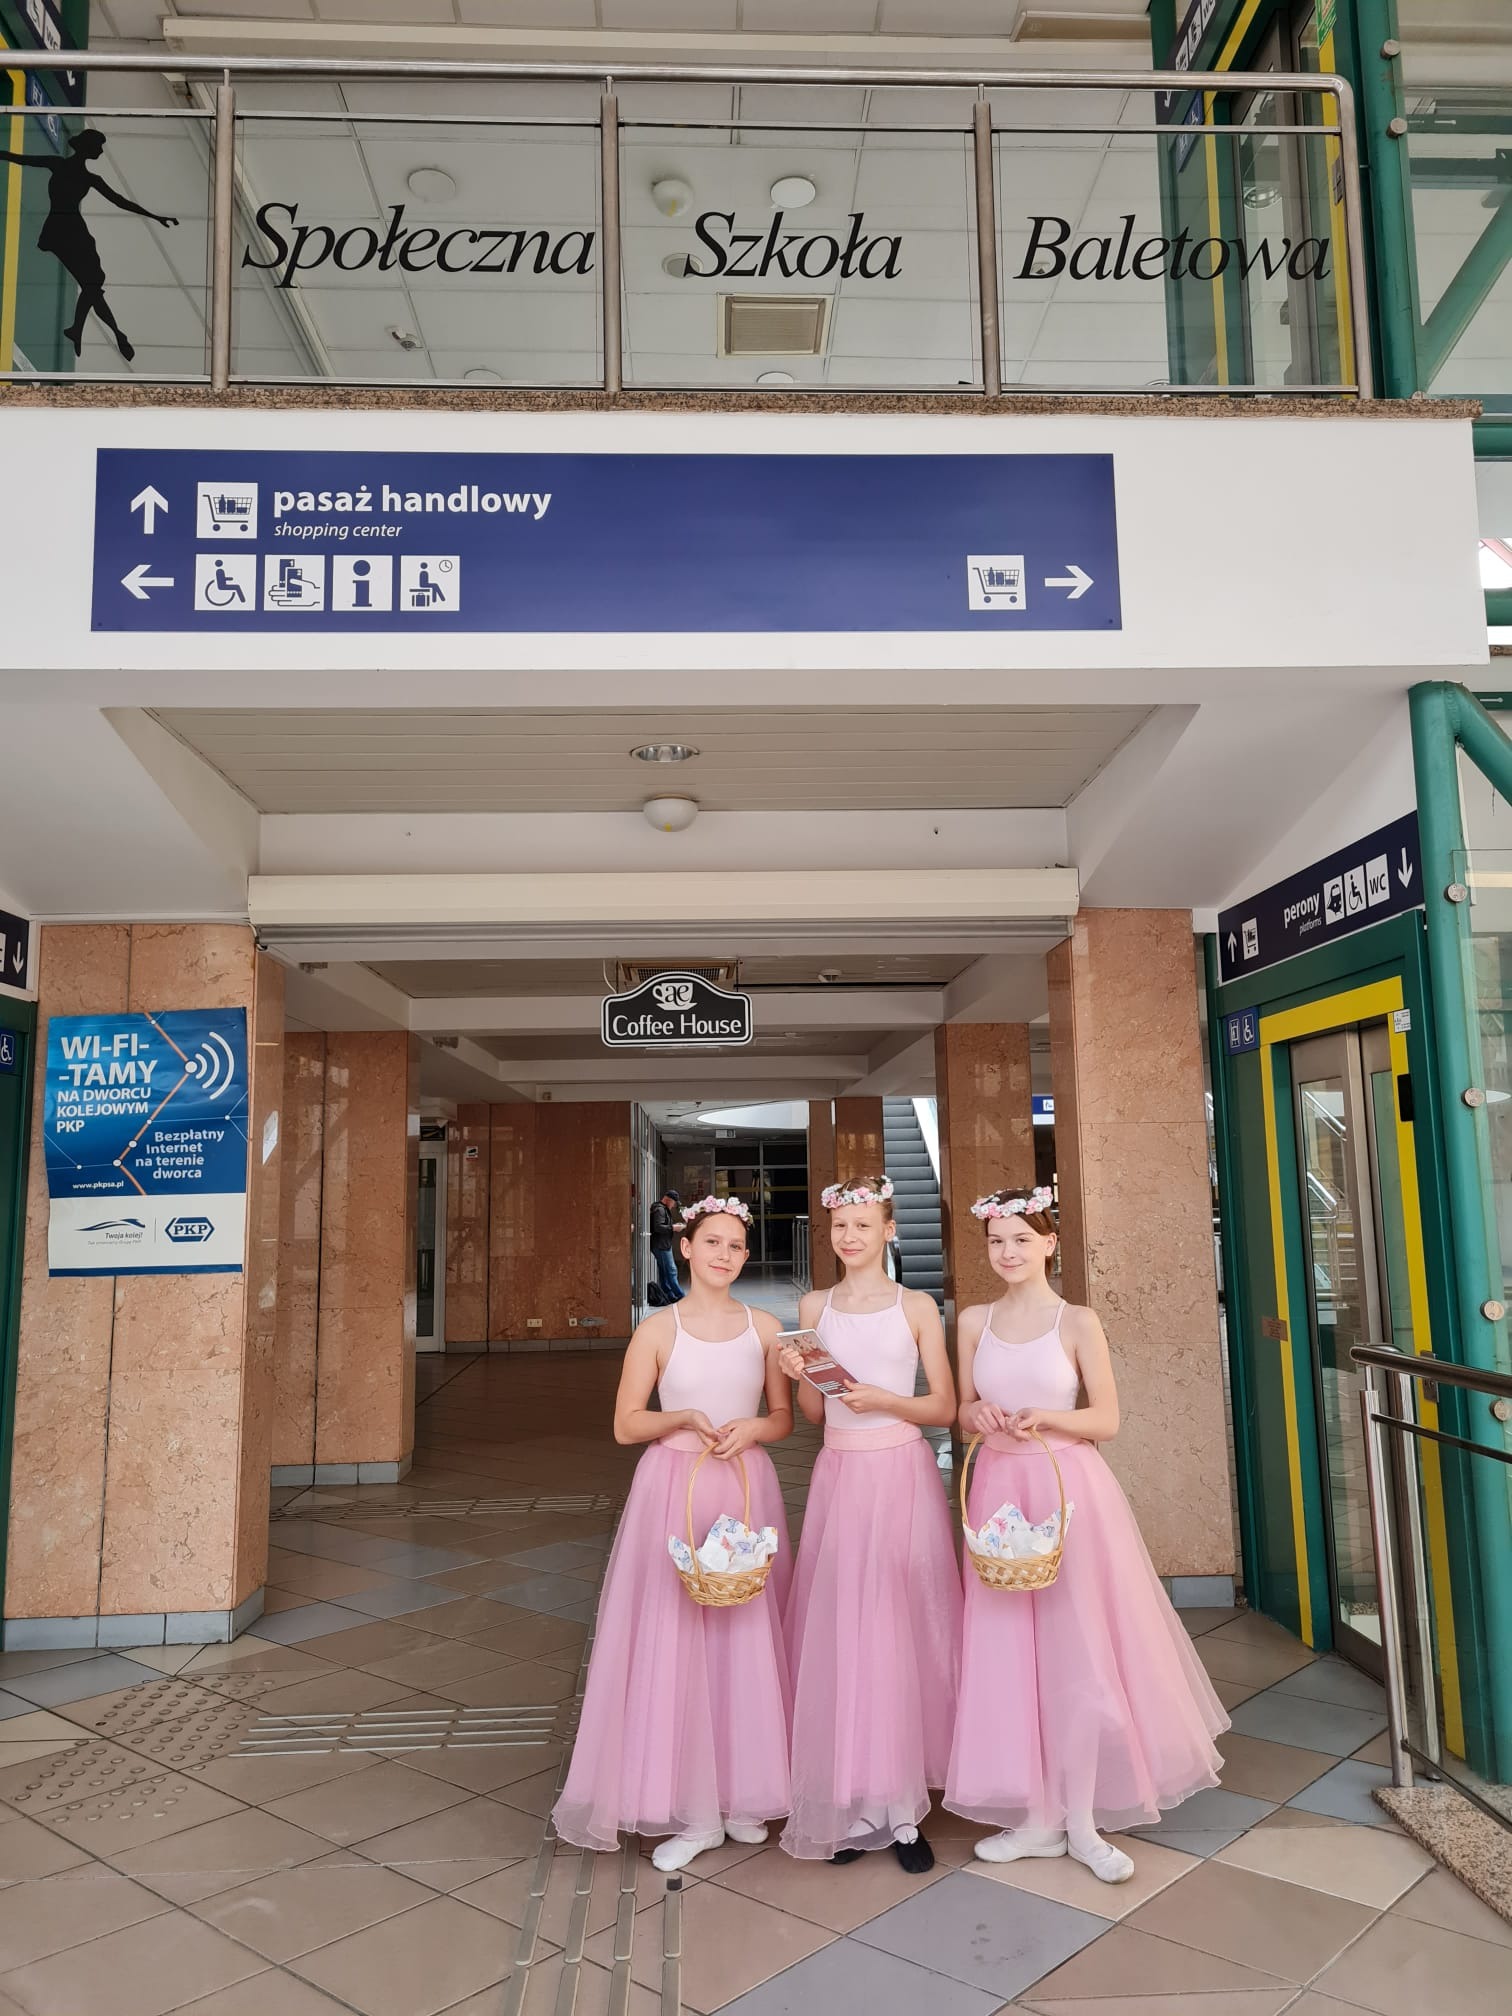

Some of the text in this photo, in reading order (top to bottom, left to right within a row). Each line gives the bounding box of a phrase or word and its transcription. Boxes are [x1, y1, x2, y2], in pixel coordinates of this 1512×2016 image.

[241, 202, 1330, 289] Społeczna Szkoła Baletowa
[274, 485, 552, 520] pasaż handlowy
[274, 523, 402, 541] shopping center
[1369, 873, 1387, 895] WC
[1283, 892, 1320, 929] perony
[1299, 917, 1322, 936] platforms
[613, 1014, 742, 1036] Coffee House
[61, 1033, 150, 1060] WI-FI-
[58, 1060, 158, 1087] -TAMY
[57, 1087, 151, 1103] NA DWORCU
[56, 1102, 149, 1118] KOLEJOWYM
[56, 1120, 85, 1133] PKP
[154, 1129, 225, 1143] Bezpłatny
[146, 1142, 203, 1154] Internet
[135, 1155, 205, 1167] na terenie
[152, 1167, 202, 1179] dworca
[72, 1180, 124, 1190] www.pkpsa.pl
[105, 1231, 124, 1240] Twoja
[173, 1224, 208, 1236] PKP
